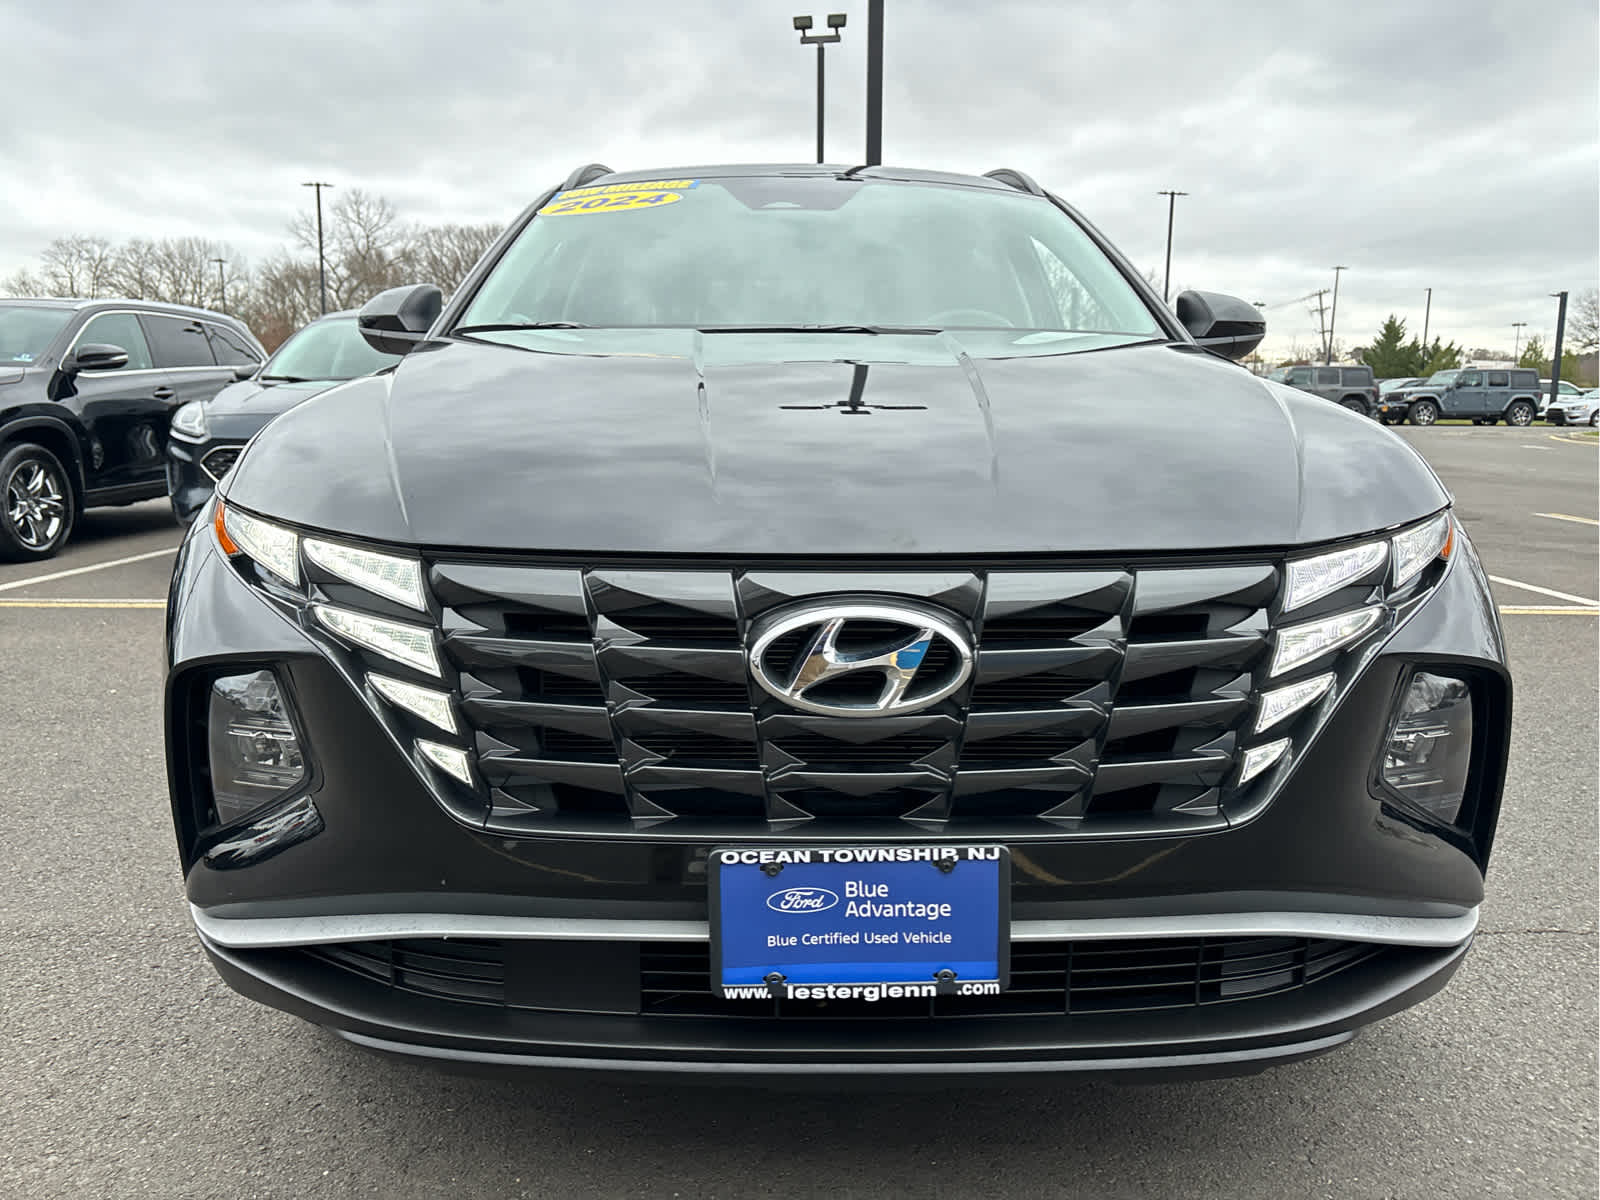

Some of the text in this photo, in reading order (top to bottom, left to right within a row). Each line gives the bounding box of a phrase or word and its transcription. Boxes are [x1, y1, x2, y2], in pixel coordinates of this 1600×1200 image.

[552, 193, 668, 213] 2024
[720, 850, 811, 864] OCEAN
[967, 846, 1001, 860] NJ
[845, 880, 889, 898] Blue
[780, 891, 825, 909] Ford
[845, 900, 952, 920] Advantage
[767, 931, 953, 947] Blue Certified Used Vehicle
[724, 982, 1001, 1002] www. lesterglenn .com
